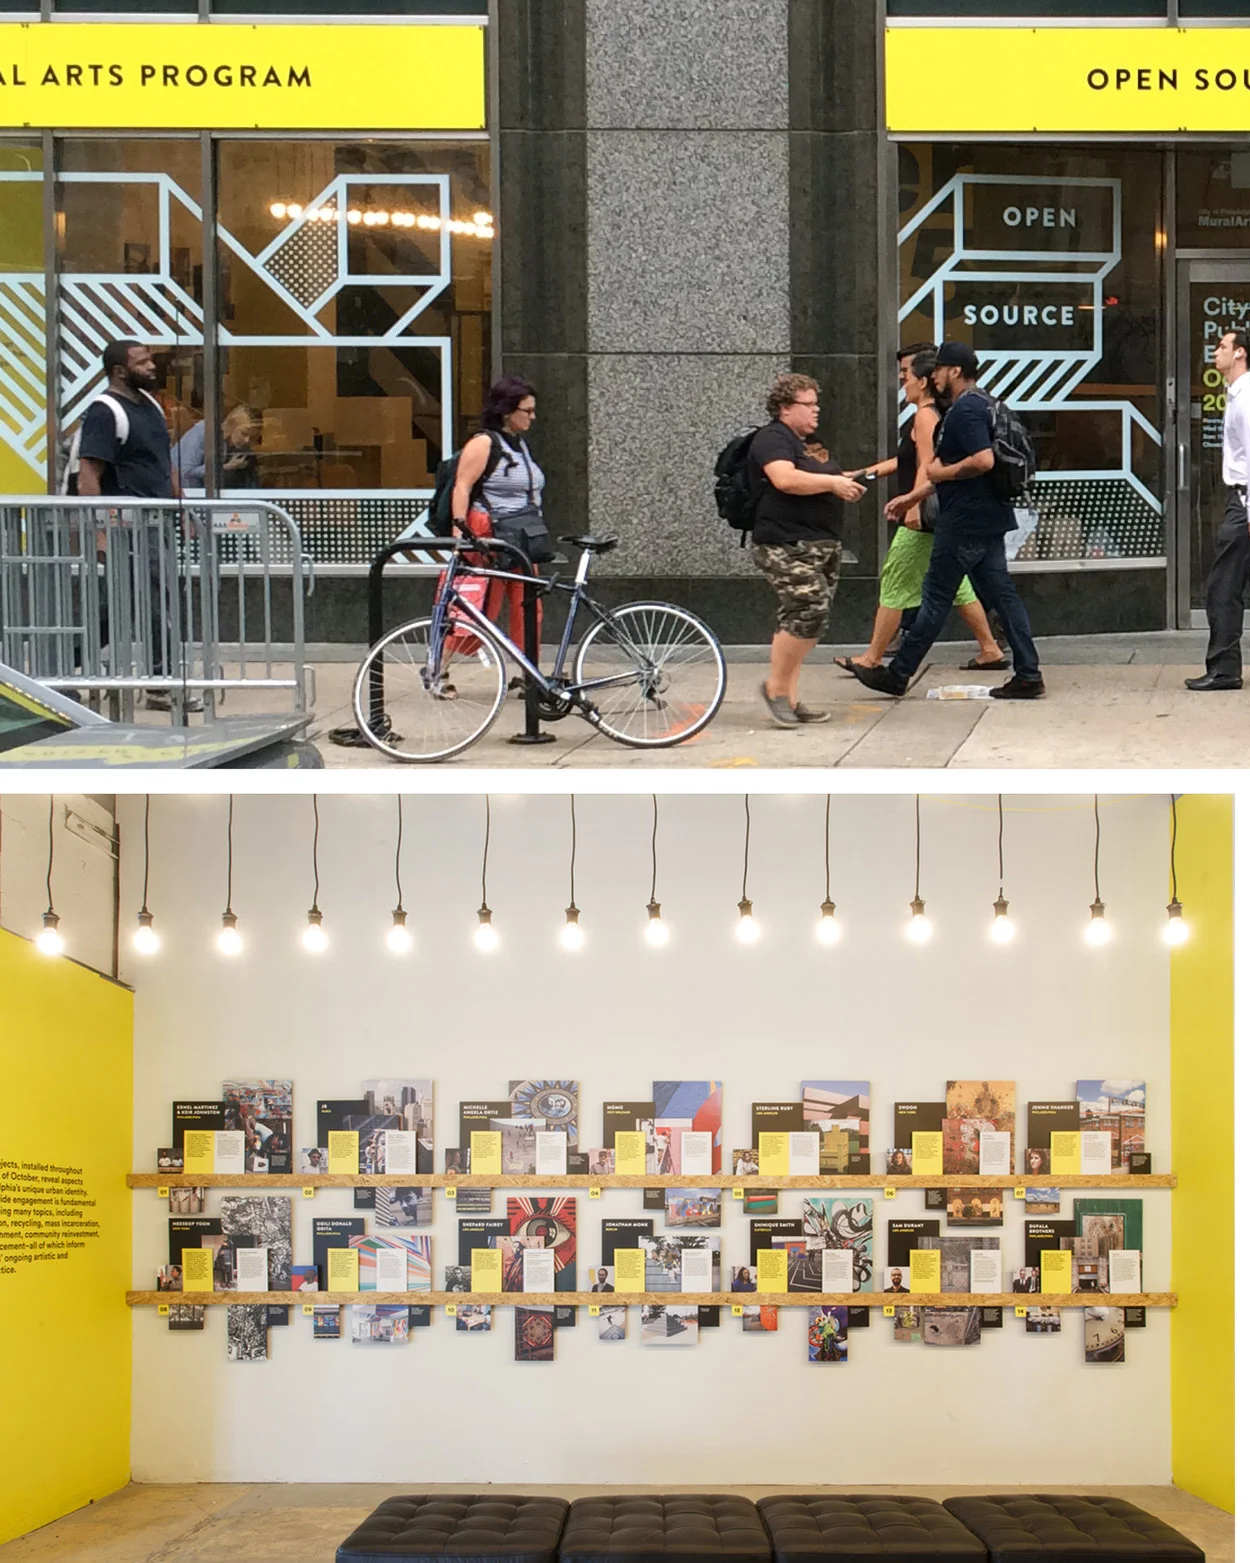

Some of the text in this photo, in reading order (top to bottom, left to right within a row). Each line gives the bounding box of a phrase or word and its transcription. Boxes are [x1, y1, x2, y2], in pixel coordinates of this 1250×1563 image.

[40, 64, 124, 86] ARTS
[140, 64, 312, 87] PROGRAM
[1087, 68, 1178, 91] OPEN
[1003, 206, 1077, 227] OPEN
[963, 304, 1075, 326] SOURCE
[21, 1161, 48, 1172] installed
[50, 1164, 83, 1175] throughout
[2, 1171, 9, 1180] of
[11, 1172, 39, 1182] October,
[61, 1177, 83, 1186] aspects
[22, 1185, 88, 1197] unique urban identity.
[13, 1197, 53, 1206] engagement
[61, 1198, 96, 1206] fundamental
[13, 1209, 31, 1217] many
[33, 1209, 54, 1217] topics,
[56, 1208, 83, 1218] including
[11, 1219, 43, 1229] recycling,
[61, 1219, 100, 1228] incarceration,
[25, 1231, 60, 1240] community
[61, 1231, 100, 1239] reinvestment,
[46, 1241, 65, 1249] which
[66, 1240, 85, 1249] inform
[4, 1251, 68, 1263] ongoing artistic and
